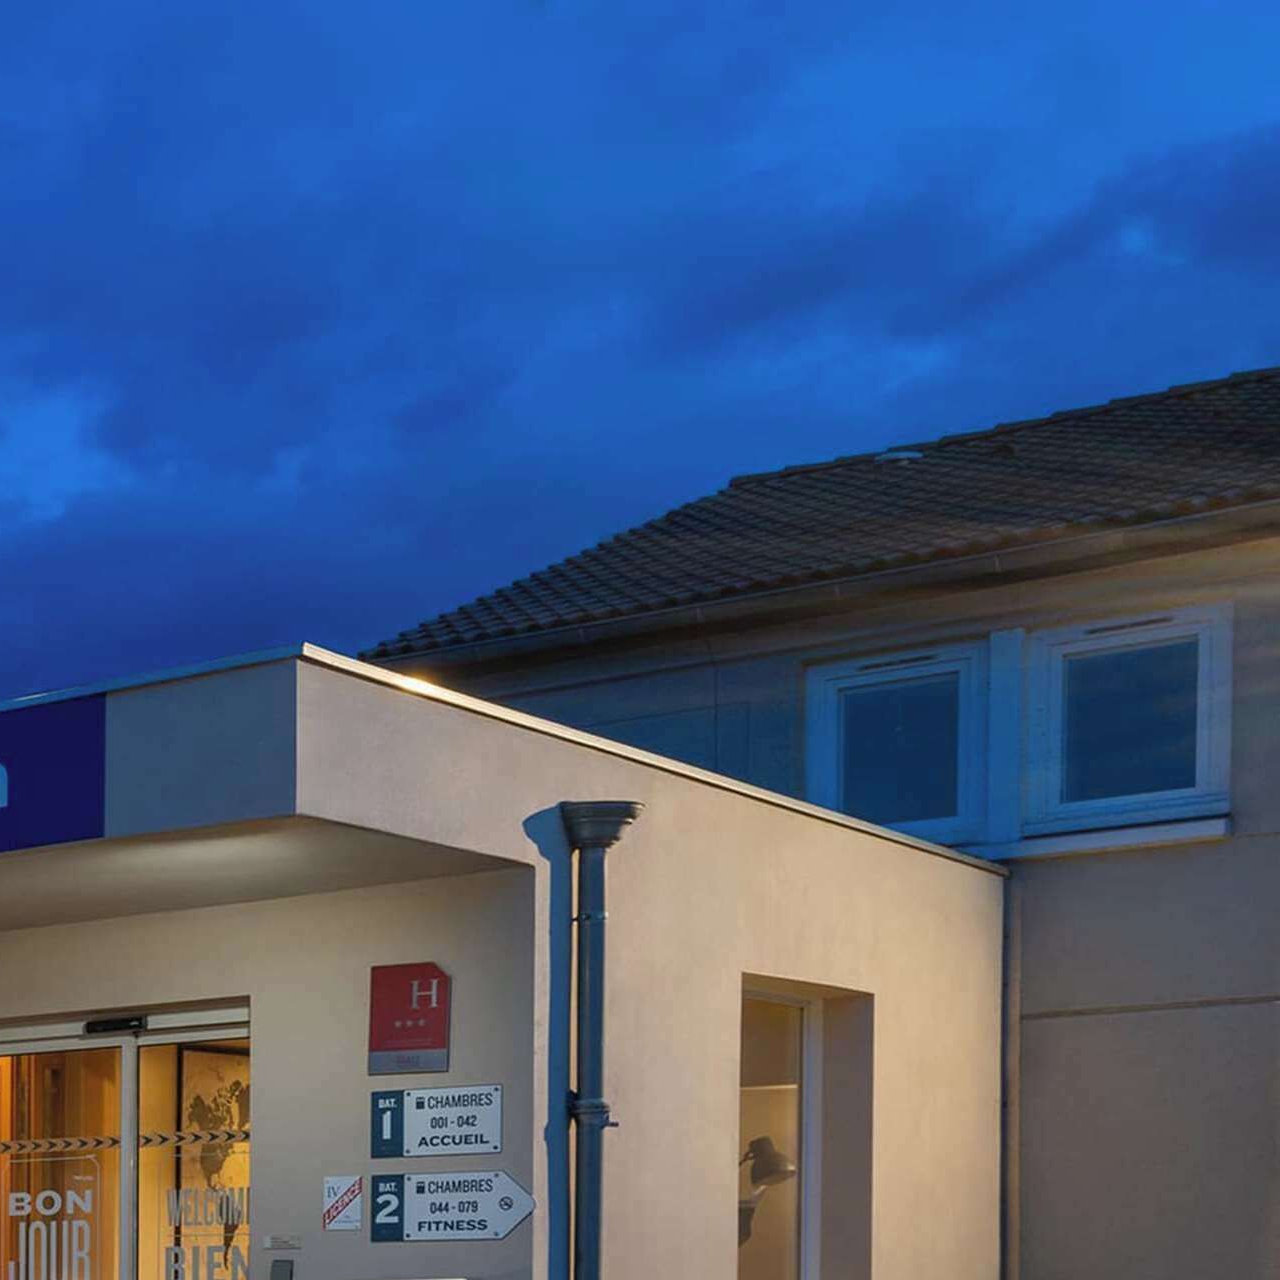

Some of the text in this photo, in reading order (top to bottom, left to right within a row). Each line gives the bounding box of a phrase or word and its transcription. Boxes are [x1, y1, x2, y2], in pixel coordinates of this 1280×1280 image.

[410, 979, 439, 1009] H
[427, 1093, 493, 1110] CHAMBRES
[382, 1110, 391, 1139] 1
[456, 1115, 477, 1128] 042
[418, 1133, 489, 1147] ACCUEIL
[428, 1178, 493, 1194] CHAMBRES
[8, 1189, 93, 1216] BON
[375, 1194, 399, 1223] 2
[430, 1202, 449, 1214] 044
[458, 1200, 478, 1213] 079
[417, 1219, 487, 1231] FITNESS
